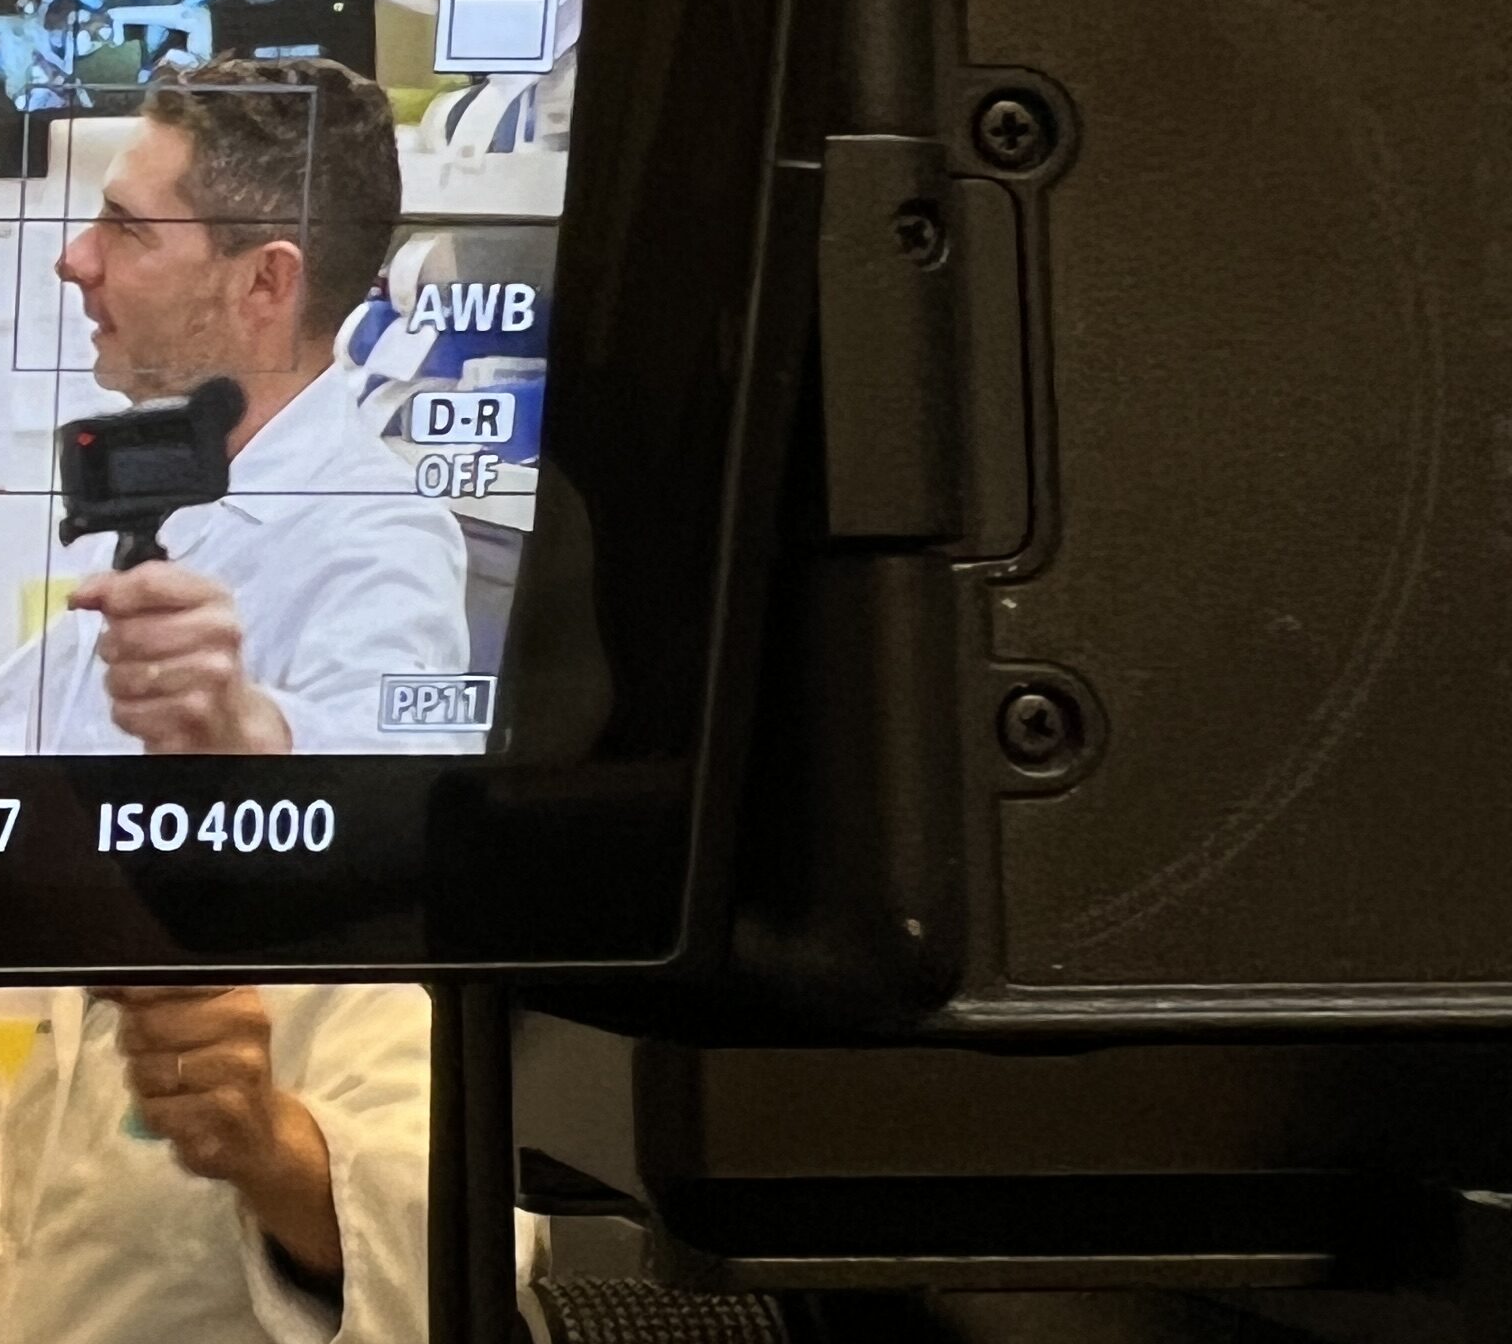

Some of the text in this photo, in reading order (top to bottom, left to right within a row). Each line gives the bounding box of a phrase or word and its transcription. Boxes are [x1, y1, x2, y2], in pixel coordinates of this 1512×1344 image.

[407, 282, 537, 333] AWB
[426, 397, 501, 438] D-R
[415, 453, 500, 498] OFF
[390, 685, 477, 722] PP11
